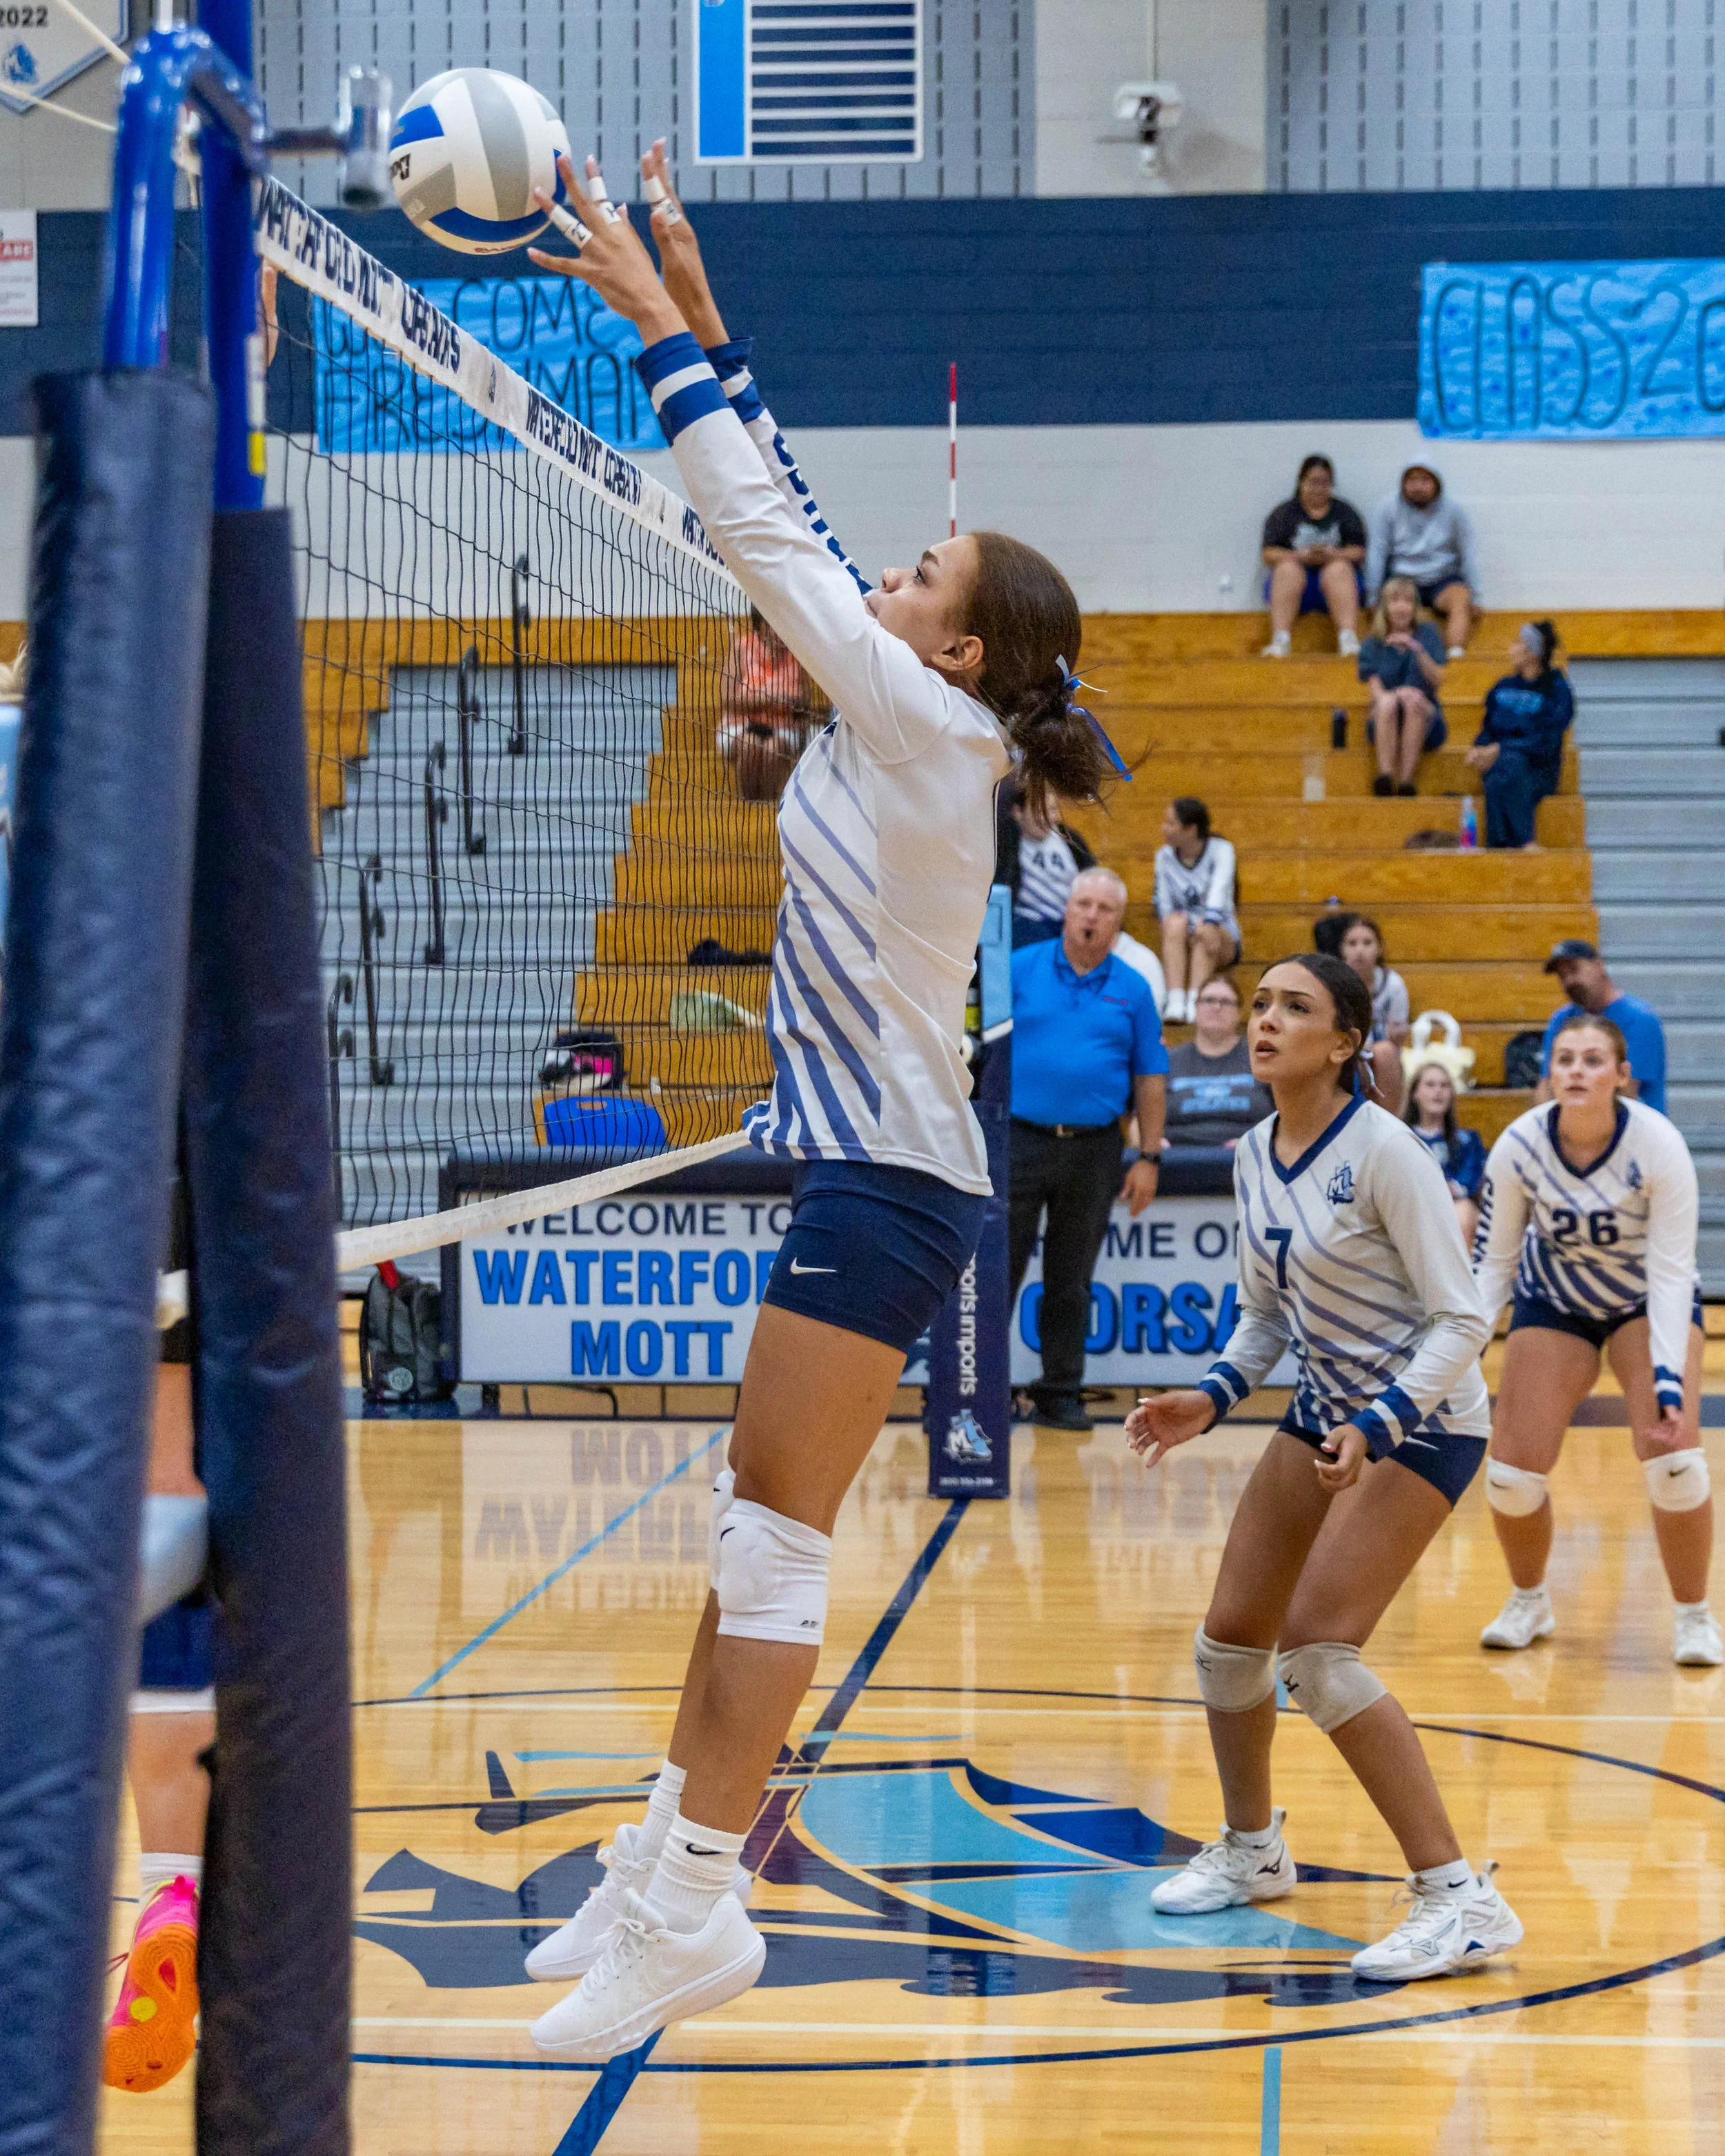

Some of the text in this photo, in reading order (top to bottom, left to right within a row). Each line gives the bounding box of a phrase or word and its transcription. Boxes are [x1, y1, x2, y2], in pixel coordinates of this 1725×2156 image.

[322, 275, 624, 355] WCOME
[506, 1201, 726, 1236] WELCOME
[1553, 1208, 1619, 1245] 26
[1265, 1227, 1292, 1289] 7
[571, 1320, 733, 1376] MOTT
